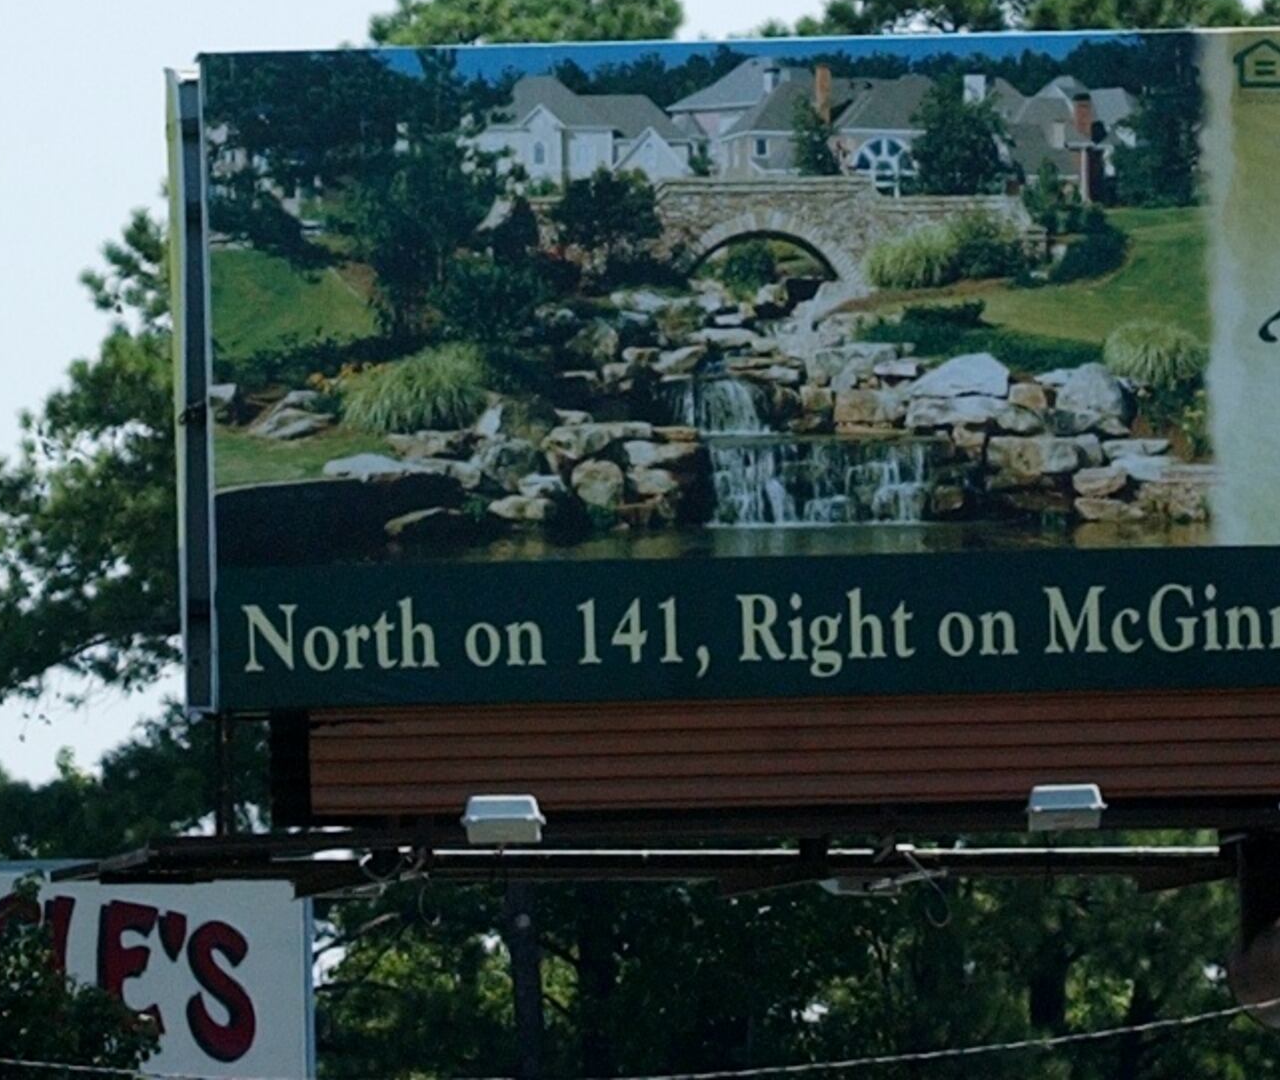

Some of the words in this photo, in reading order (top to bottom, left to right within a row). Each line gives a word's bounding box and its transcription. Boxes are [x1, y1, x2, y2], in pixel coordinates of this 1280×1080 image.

[241, 596, 440, 672] North
[464, 616, 547, 668] on
[577, 595, 711, 678] 141,
[736, 587, 916, 678] Right
[937, 608, 1019, 658] on
